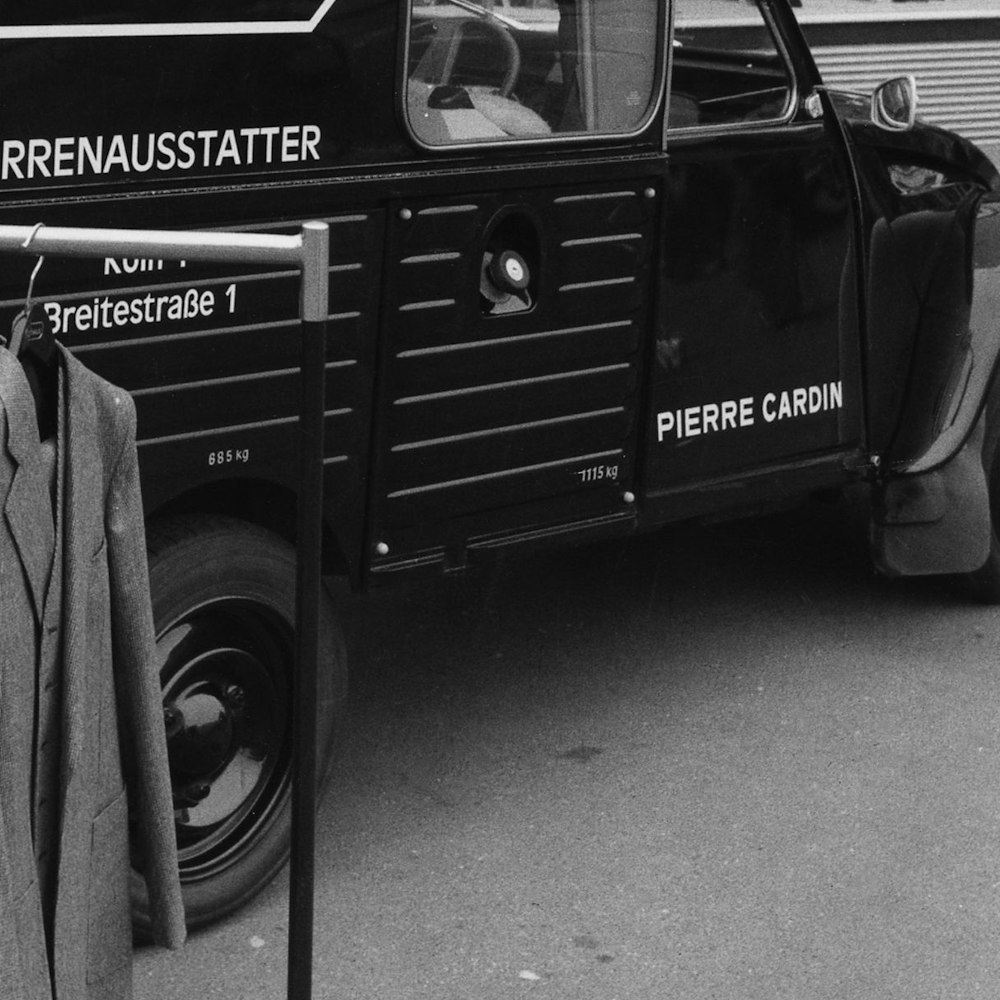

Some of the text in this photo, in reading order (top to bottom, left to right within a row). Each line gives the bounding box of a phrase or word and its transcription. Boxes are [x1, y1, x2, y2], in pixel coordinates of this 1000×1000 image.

[43, 288, 215, 335] Breitestraße
[225, 283, 237, 314] 1
[656, 380, 843, 442] PIERRE CARDIN
[208, 449, 249, 466] 685 kg
